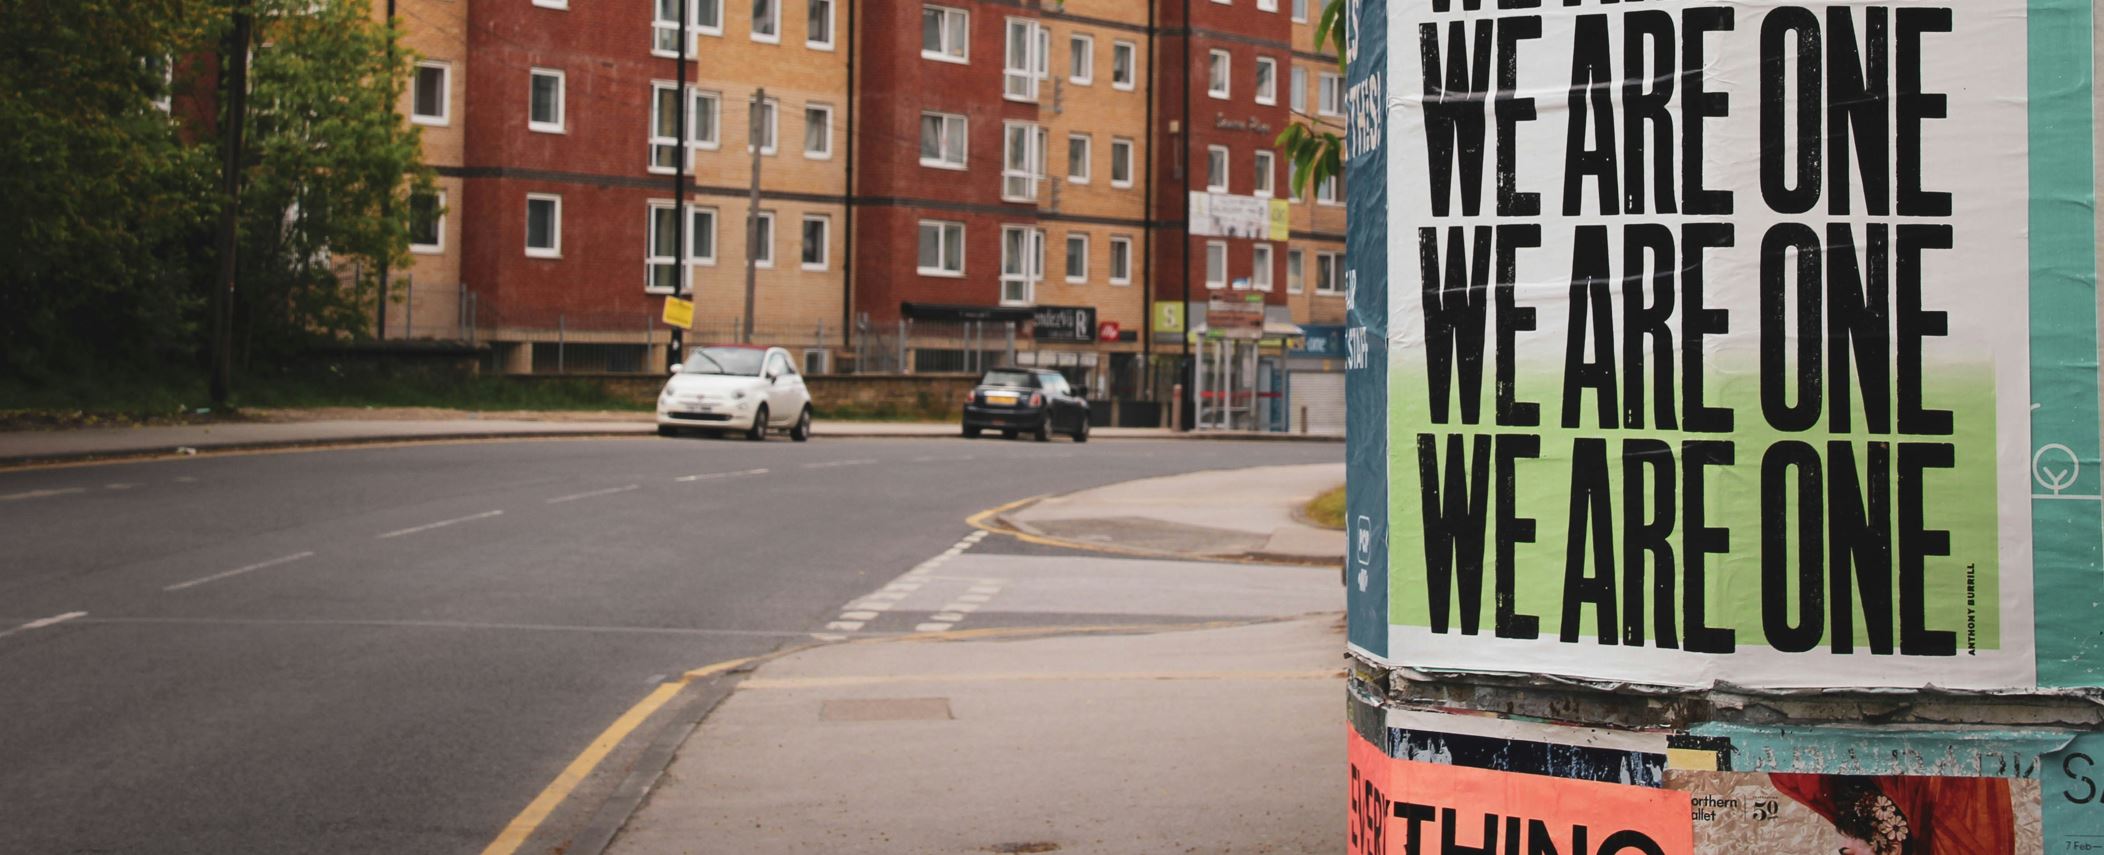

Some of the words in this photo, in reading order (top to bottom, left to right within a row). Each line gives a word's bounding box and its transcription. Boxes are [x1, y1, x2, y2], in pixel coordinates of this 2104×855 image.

[1418, 15, 1542, 217] WE
[1561, 7, 1735, 217] ARE
[1760, 6, 1953, 217] ONE
[1418, 224, 1542, 426] WE
[1561, 223, 1735, 433] ARE
[1760, 223, 1954, 435] ONE
[1417, 433, 1541, 640] WE
[1560, 437, 1736, 654] ARE
[1760, 440, 1957, 657] ONE
[1966, 563, 1975, 606] BURRILL
[1967, 609, 1976, 656] ANTHONY
